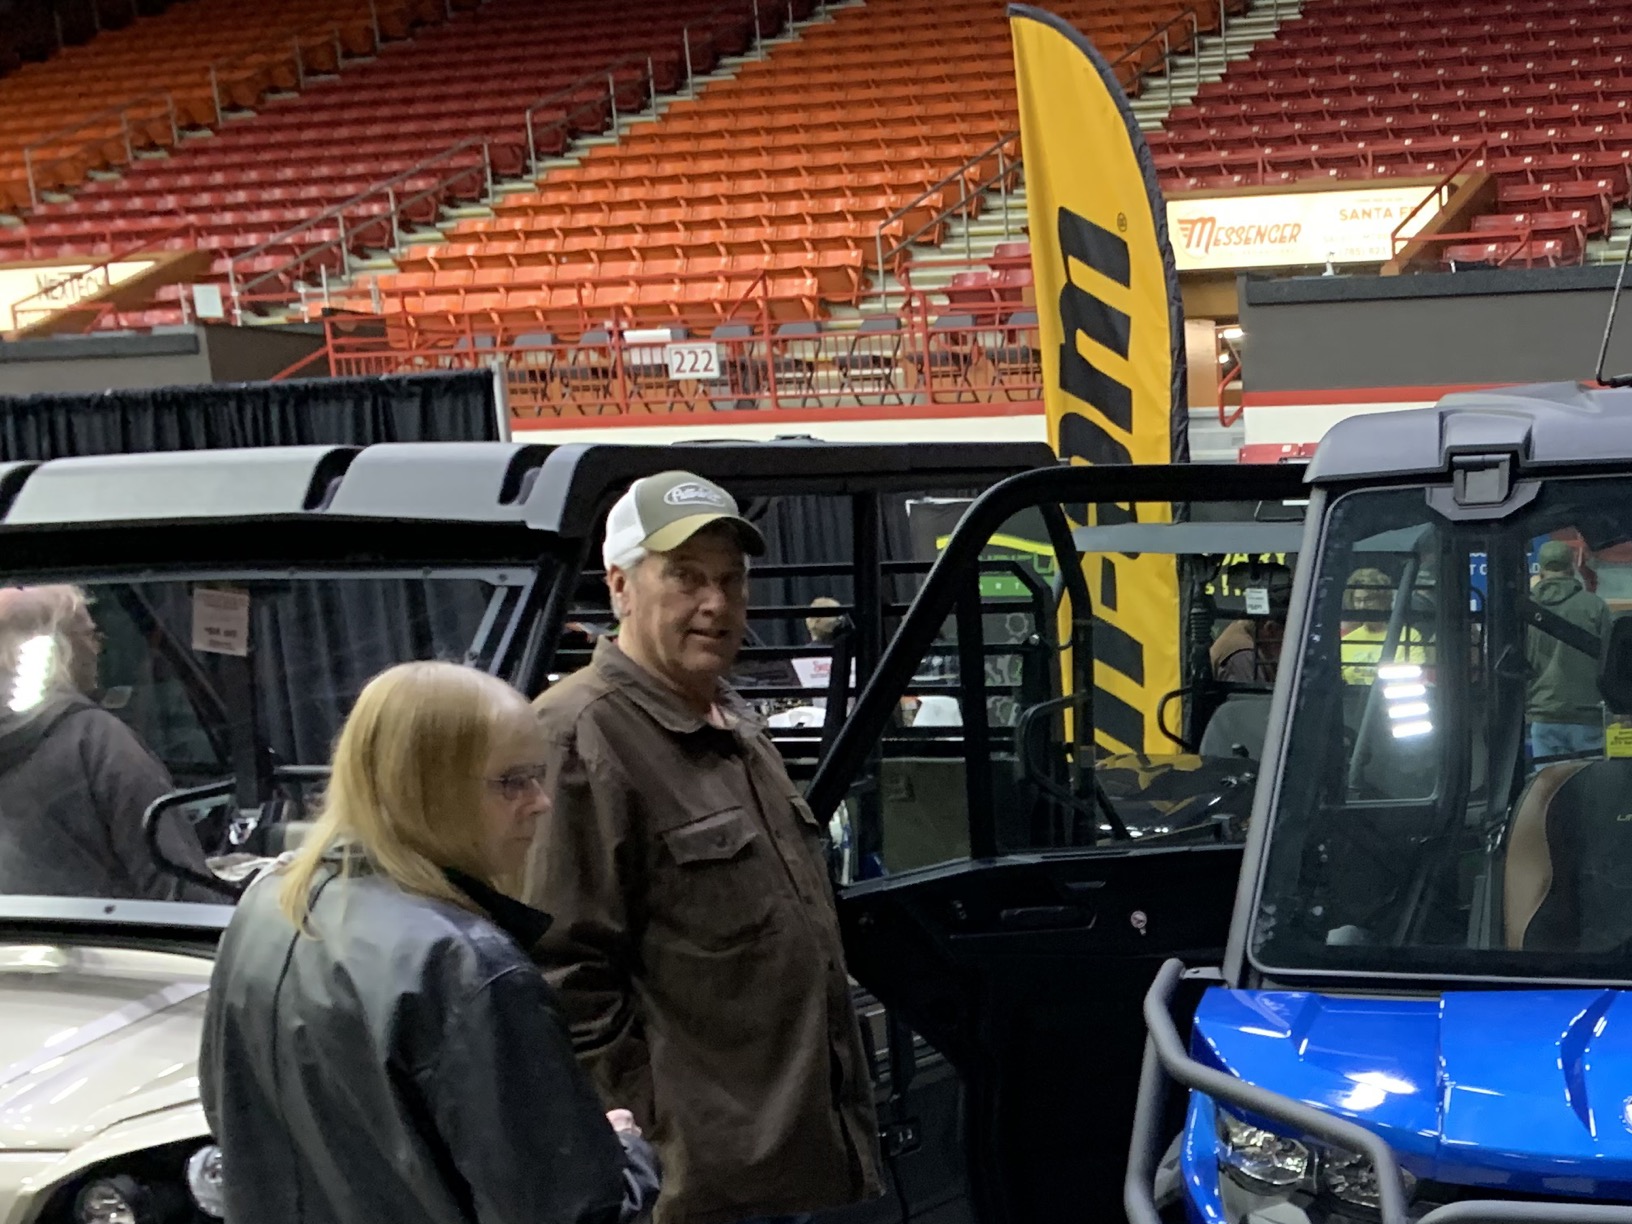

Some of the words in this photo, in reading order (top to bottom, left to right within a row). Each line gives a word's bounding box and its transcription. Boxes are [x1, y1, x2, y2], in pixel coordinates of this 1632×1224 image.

[1339, 206, 1393, 221] SANTA
[1178, 216, 1302, 254] MESSENGER
[674, 350, 714, 373] 222
